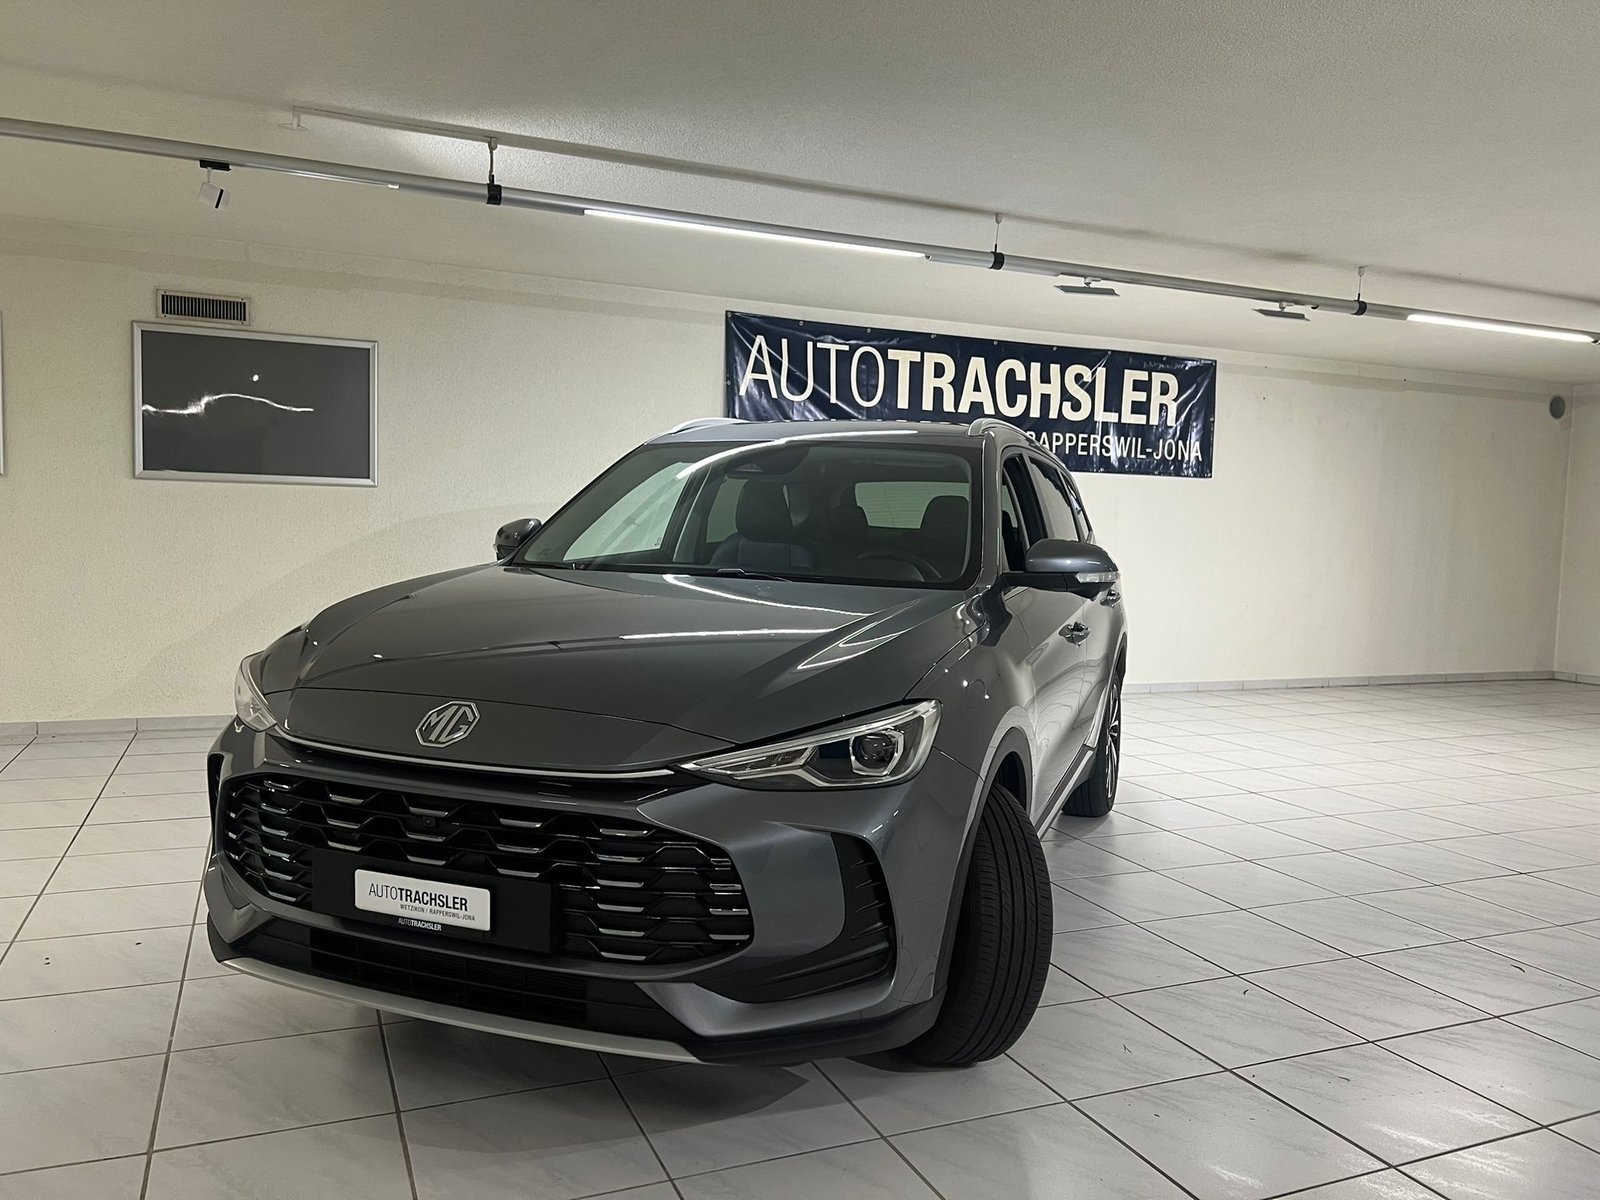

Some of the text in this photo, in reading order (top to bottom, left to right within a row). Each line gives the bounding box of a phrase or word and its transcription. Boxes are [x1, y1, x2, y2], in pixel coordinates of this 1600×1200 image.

[739, 334, 1180, 428] AUTOTRACHSLER
[422, 705, 475, 743] MG
[368, 883, 468, 912] AUTOTRACHSLER
[398, 918, 442, 931] AUTOTRACHSLER
